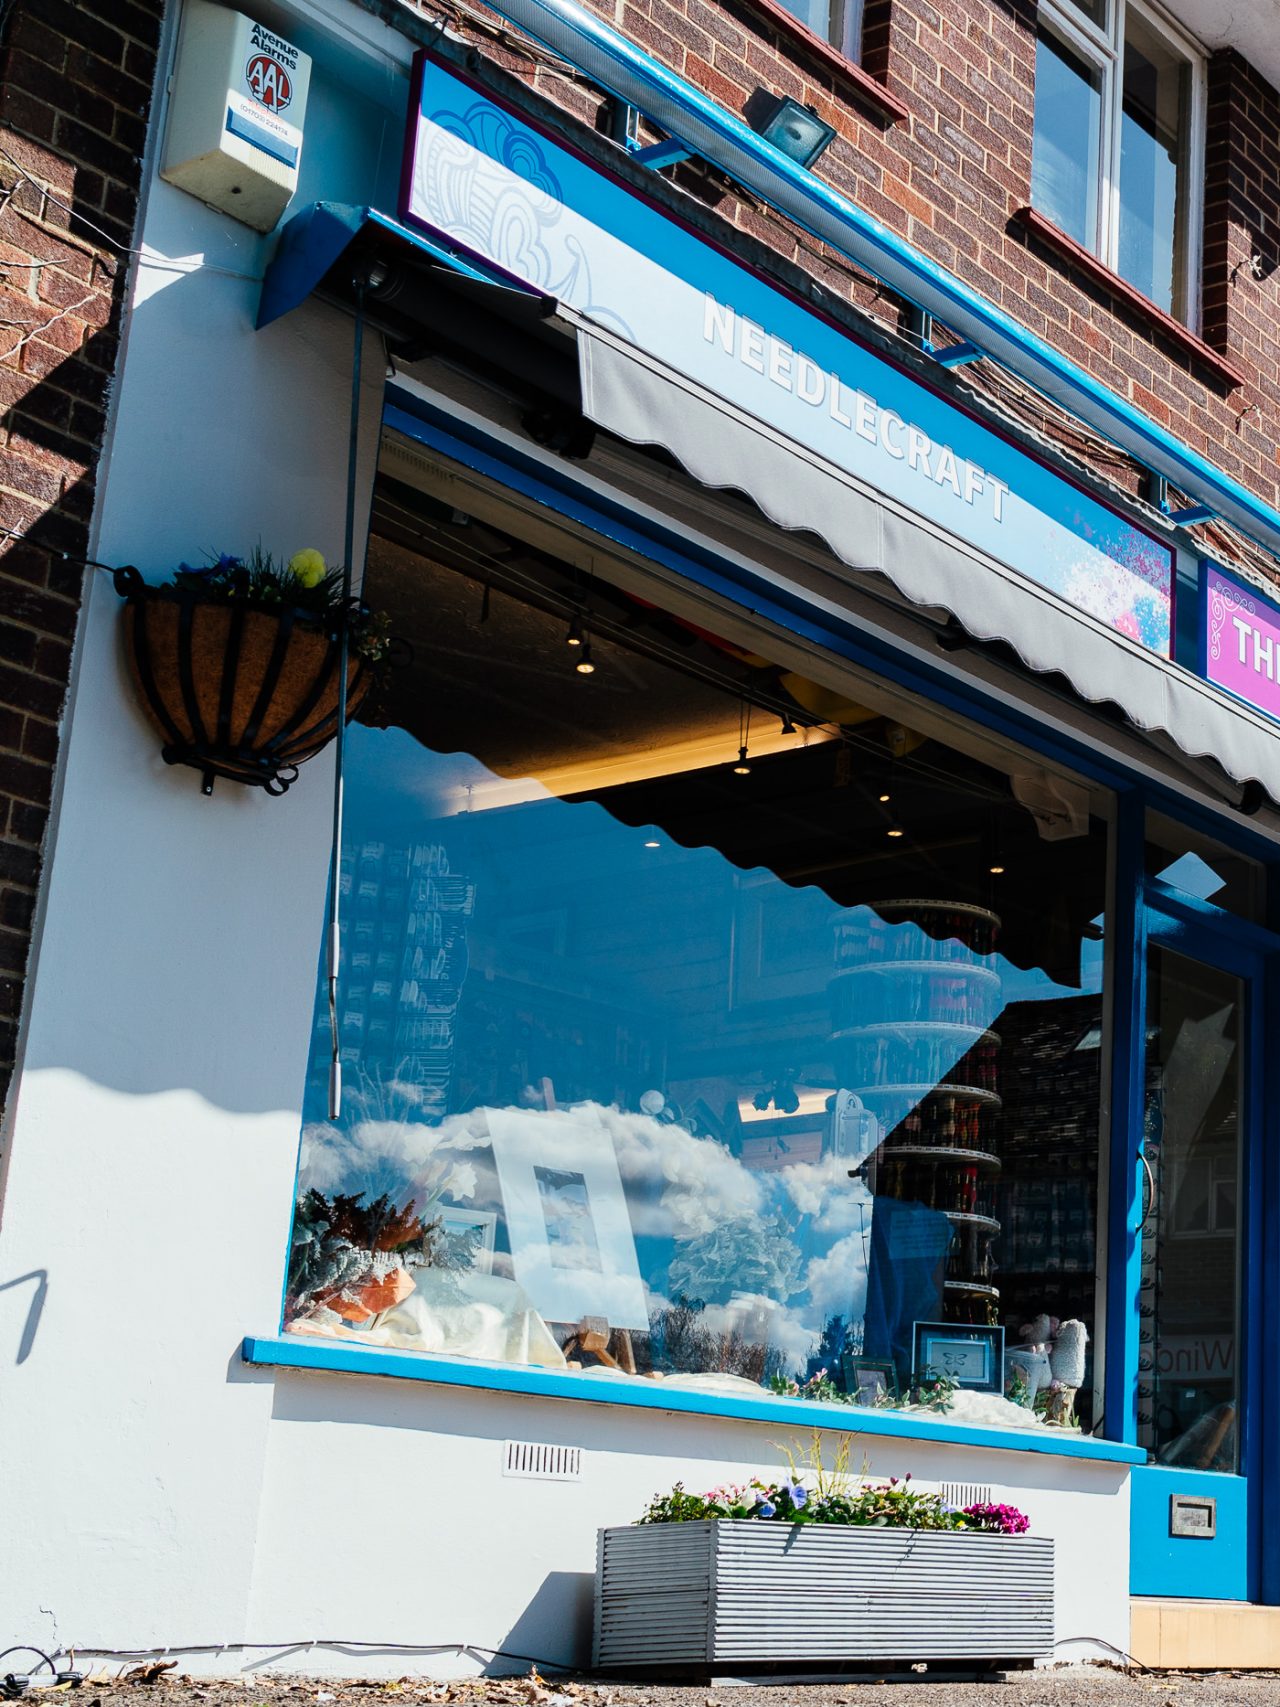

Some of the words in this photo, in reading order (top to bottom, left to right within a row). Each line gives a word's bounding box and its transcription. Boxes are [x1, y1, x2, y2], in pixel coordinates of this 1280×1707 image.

[250, 34, 297, 71] Alarms
[251, 23, 299, 59] Avenue
[246, 54, 292, 114] AAL
[703, 291, 1010, 523] NEEDLECRAFT
